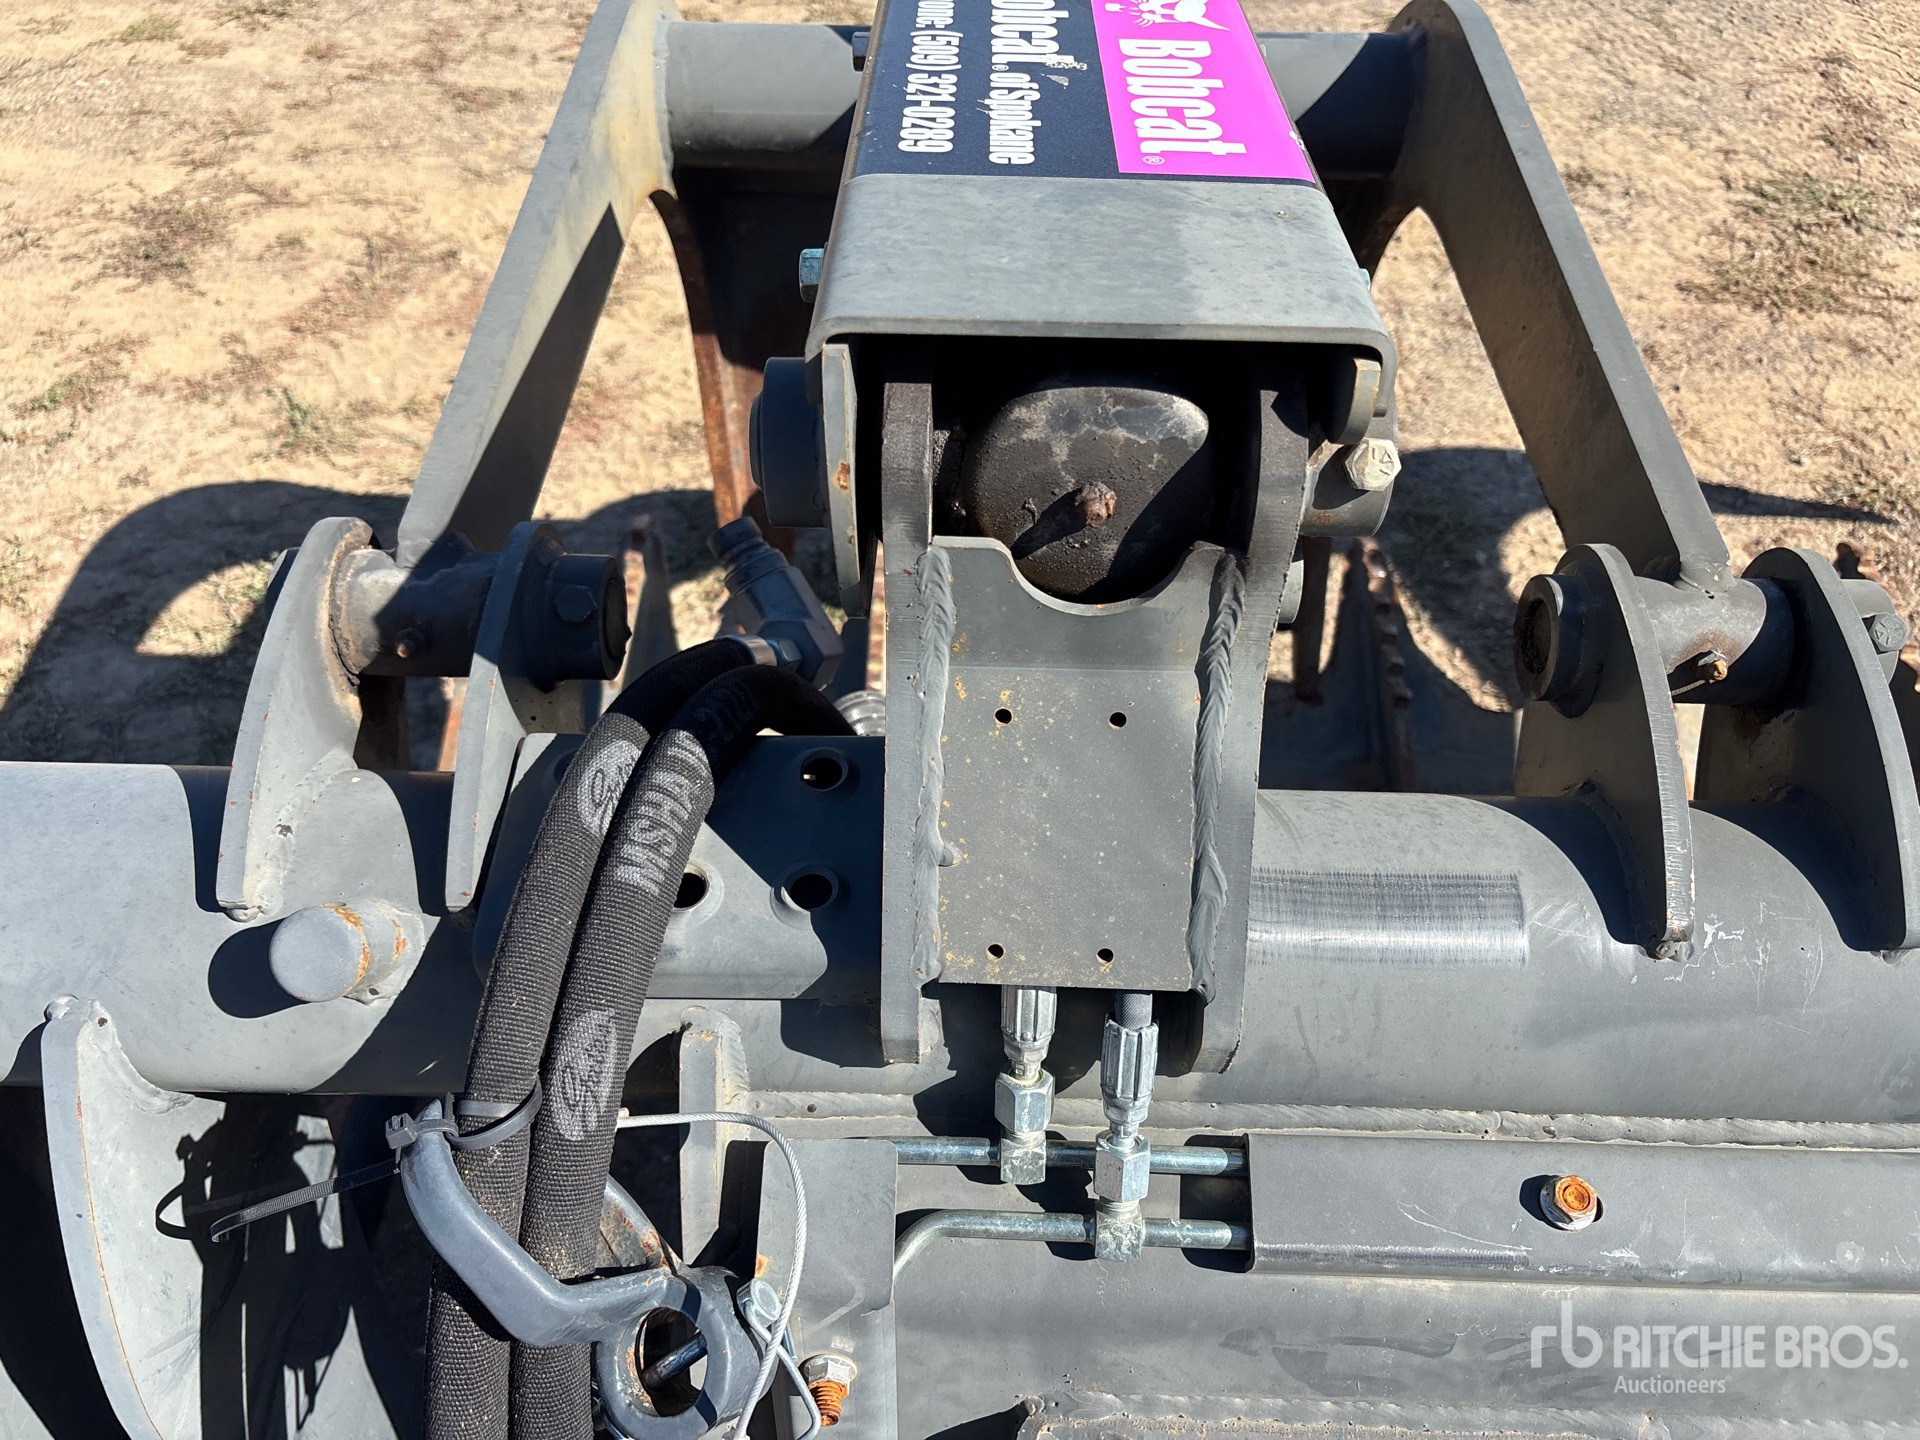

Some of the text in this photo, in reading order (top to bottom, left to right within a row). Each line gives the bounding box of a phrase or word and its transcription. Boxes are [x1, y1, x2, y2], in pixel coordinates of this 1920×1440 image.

[898, 0, 964, 153] one: (509) 321-0289
[989, 72, 1040, 89] of
[1118, 38, 1247, 156] Bobcat
[985, 89, 1042, 165] Spokane
